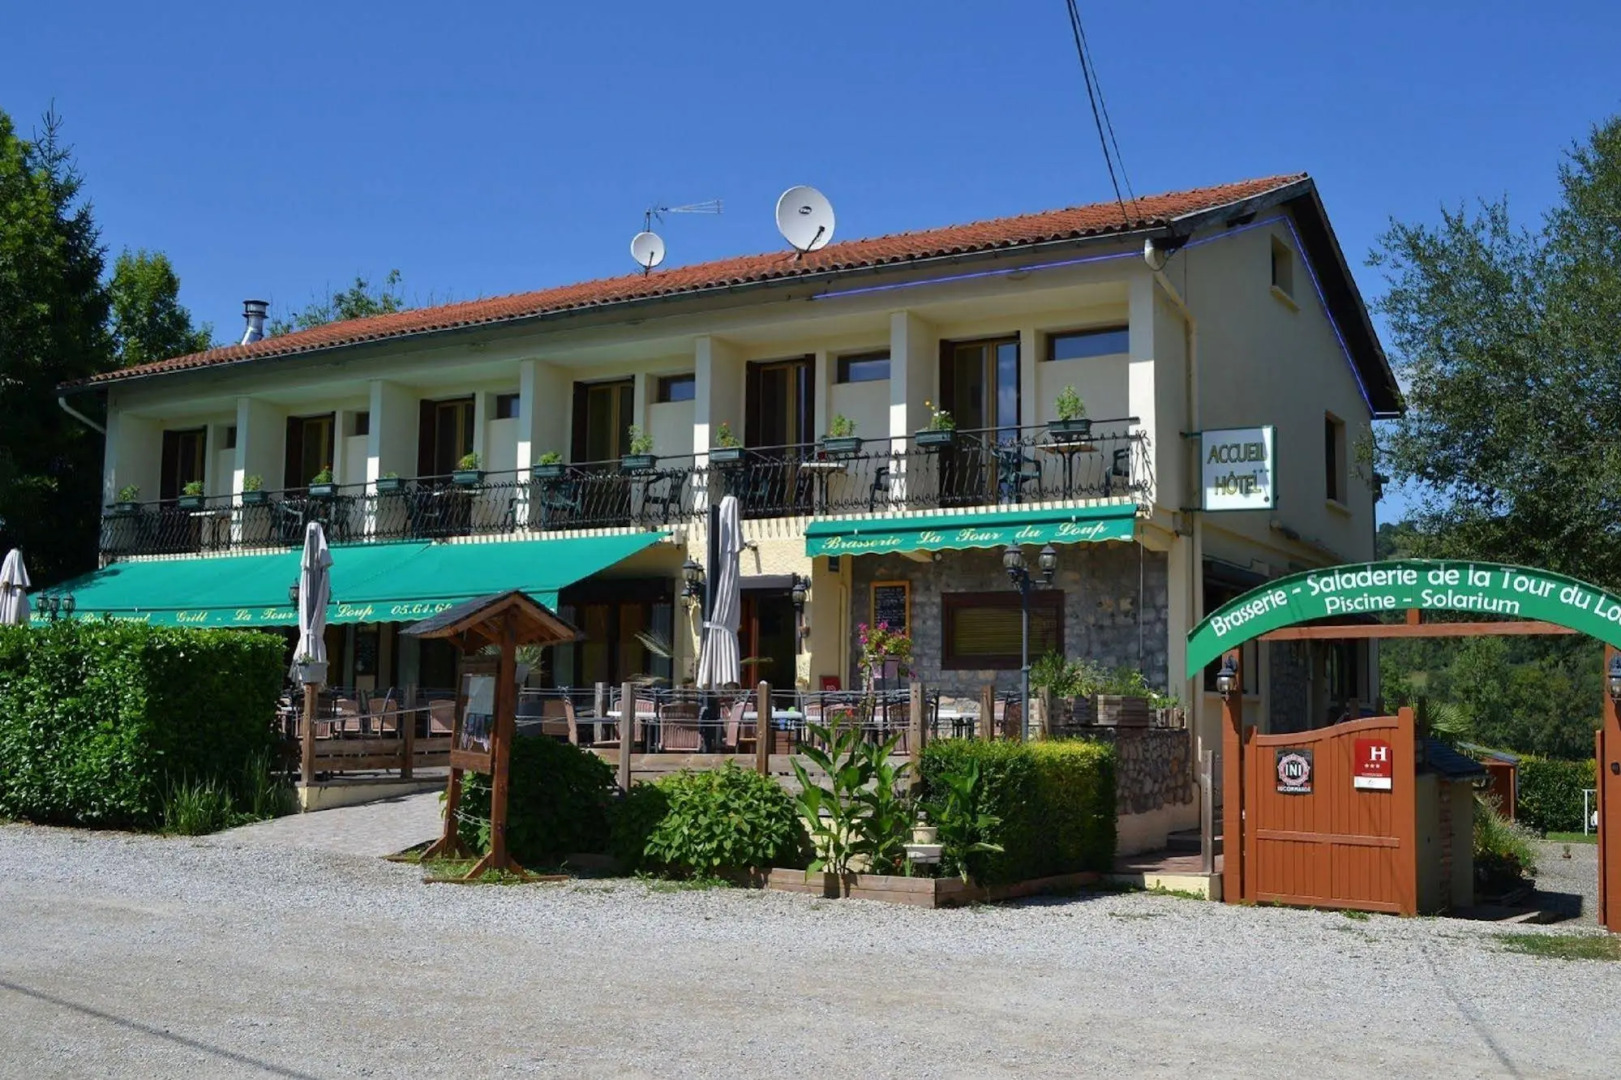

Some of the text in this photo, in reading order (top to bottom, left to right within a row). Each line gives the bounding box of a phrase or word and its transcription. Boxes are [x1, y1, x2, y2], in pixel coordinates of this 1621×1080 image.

[1206, 442, 1268, 465] ACCUEIL
[1214, 470, 1262, 496] HÔTEL
[822, 521, 1108, 550] Brasserie La Tour du Loup
[1210, 589, 1288, 637] Brasserie
[1306, 564, 1418, 596] Saladerie
[1427, 562, 1460, 586] de
[1467, 564, 1491, 588] la
[1500, 567, 1556, 598] Tour
[1560, 583, 1592, 610] du
[1593, 592, 1621, 626] Lo
[1324, 593, 1396, 615] Piscine
[1421, 589, 1520, 614] Solarium
[176, 610, 208, 623] Grill
[233, 608, 252, 621] La
[260, 608, 296, 620] Tour
[335, 603, 375, 620] Loup
[1370, 746, 1388, 762] H
